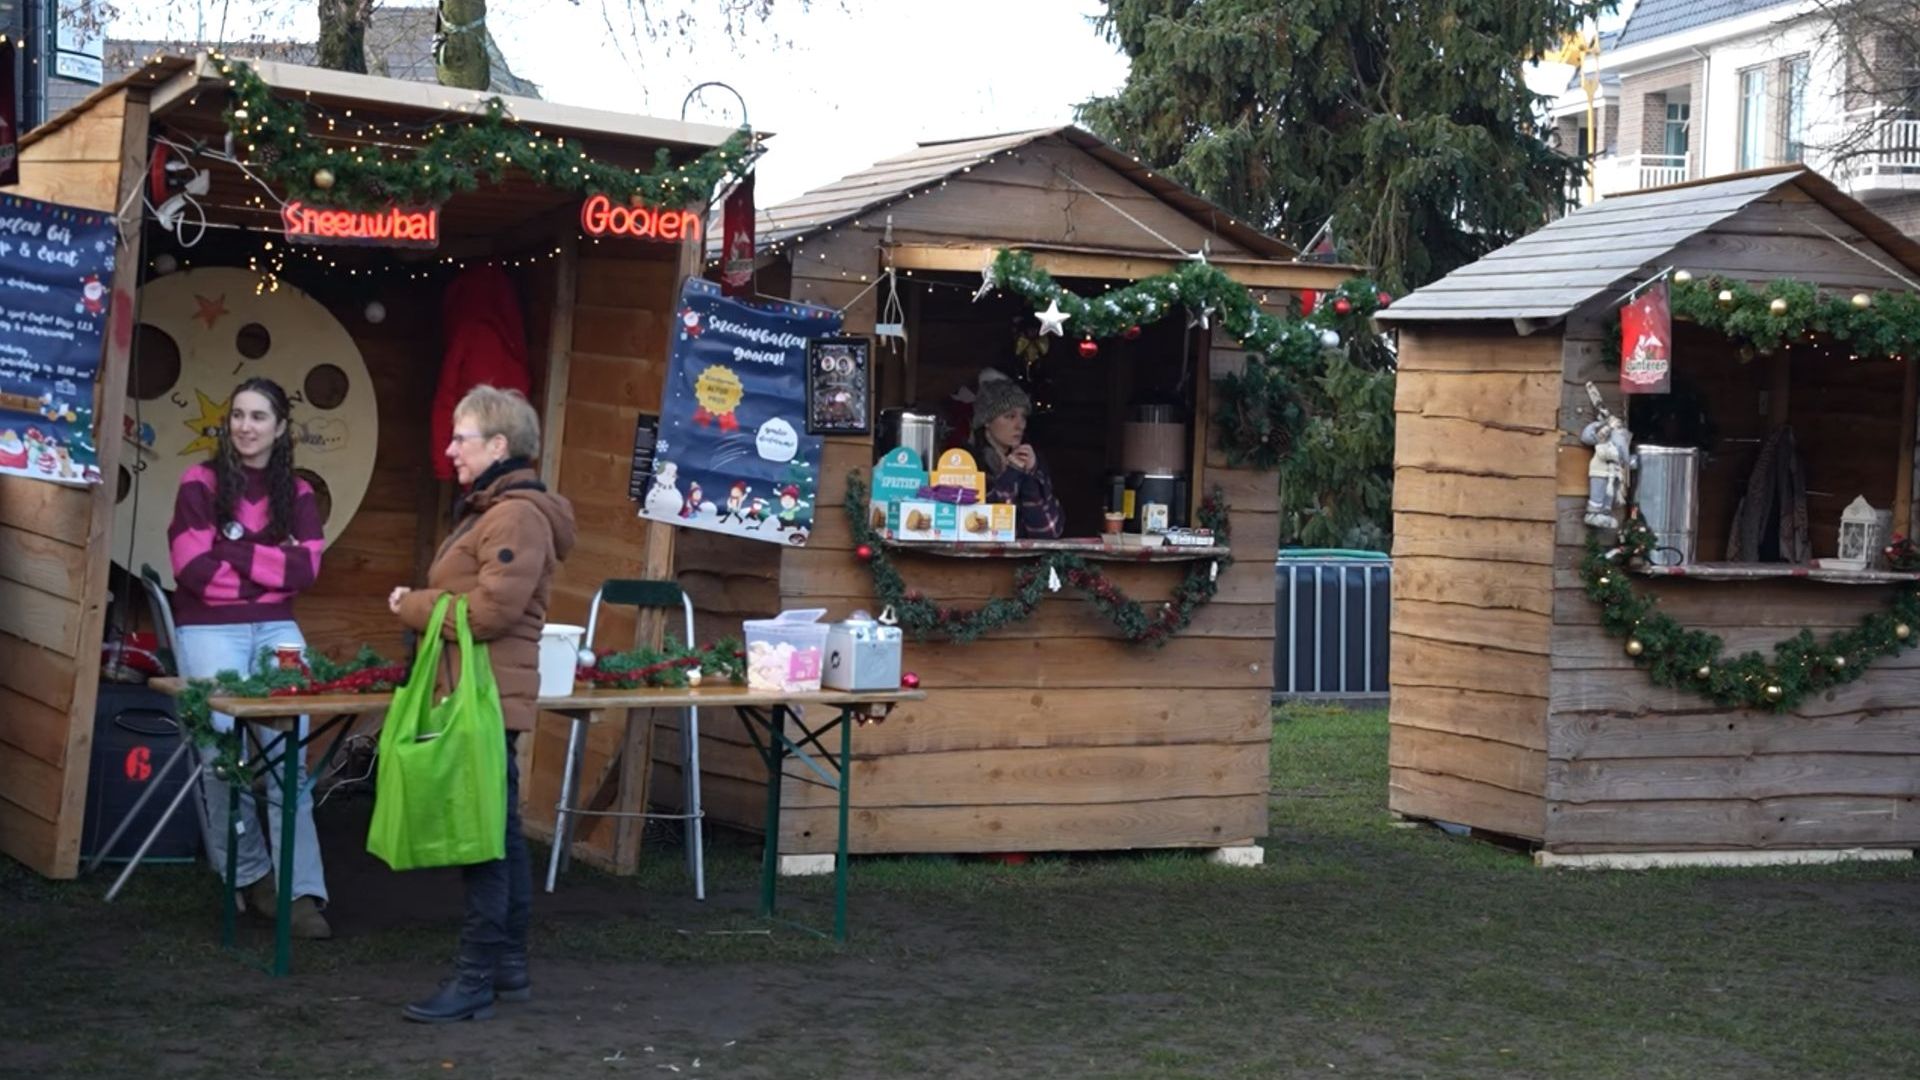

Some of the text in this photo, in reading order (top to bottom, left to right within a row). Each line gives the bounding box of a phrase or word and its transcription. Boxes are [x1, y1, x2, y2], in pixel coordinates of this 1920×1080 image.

[285, 200, 437, 240] Sneeuwbal
[584, 194, 701, 241] Gooien
[709, 315, 806, 349] Sneeuwballen
[125, 747, 152, 780] 6
